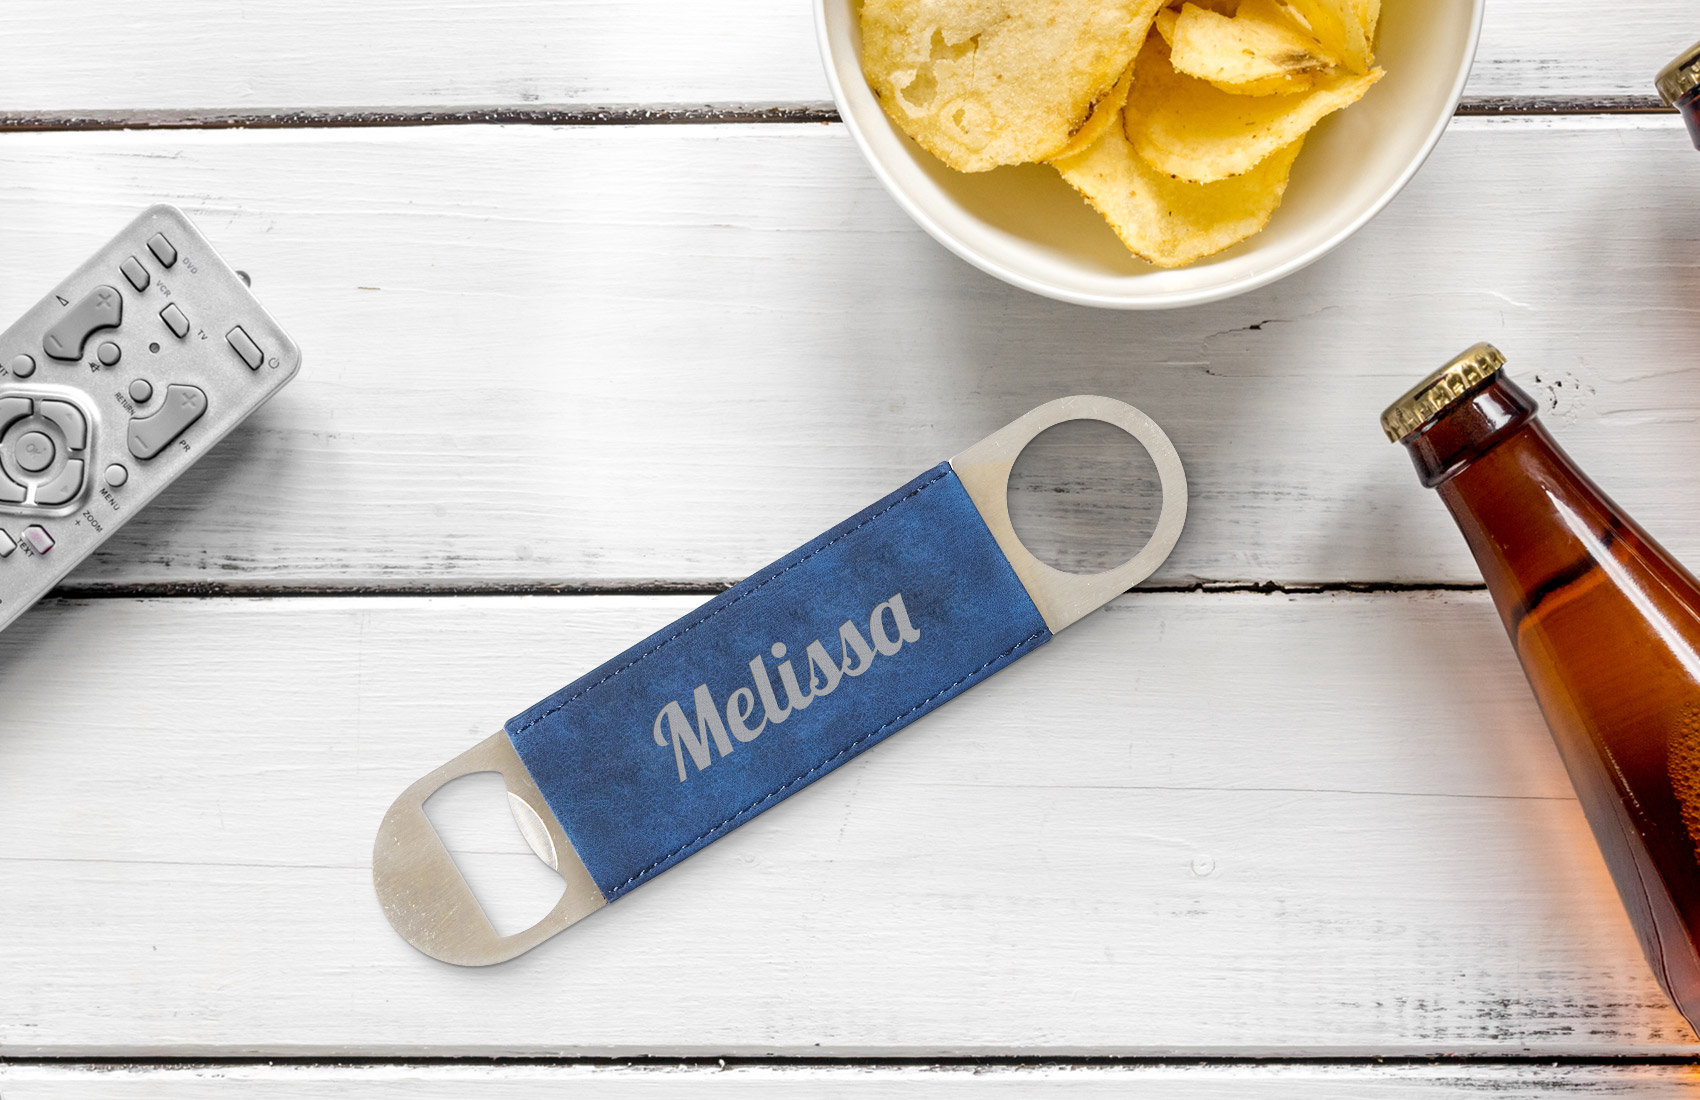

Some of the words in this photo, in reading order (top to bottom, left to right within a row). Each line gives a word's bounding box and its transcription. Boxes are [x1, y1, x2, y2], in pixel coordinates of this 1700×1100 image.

[182, 256, 198, 275] DVD
[156, 280, 172, 298] VCR
[197, 329, 208, 341] TV
[114, 391, 136, 416] RETURN
[179, 439, 191, 453] PR
[99, 487, 121, 512] MENU
[82, 510, 103, 533] ZOOM
[17, 537, 35, 558] TEXT
[653, 592, 921, 783] Melissa
